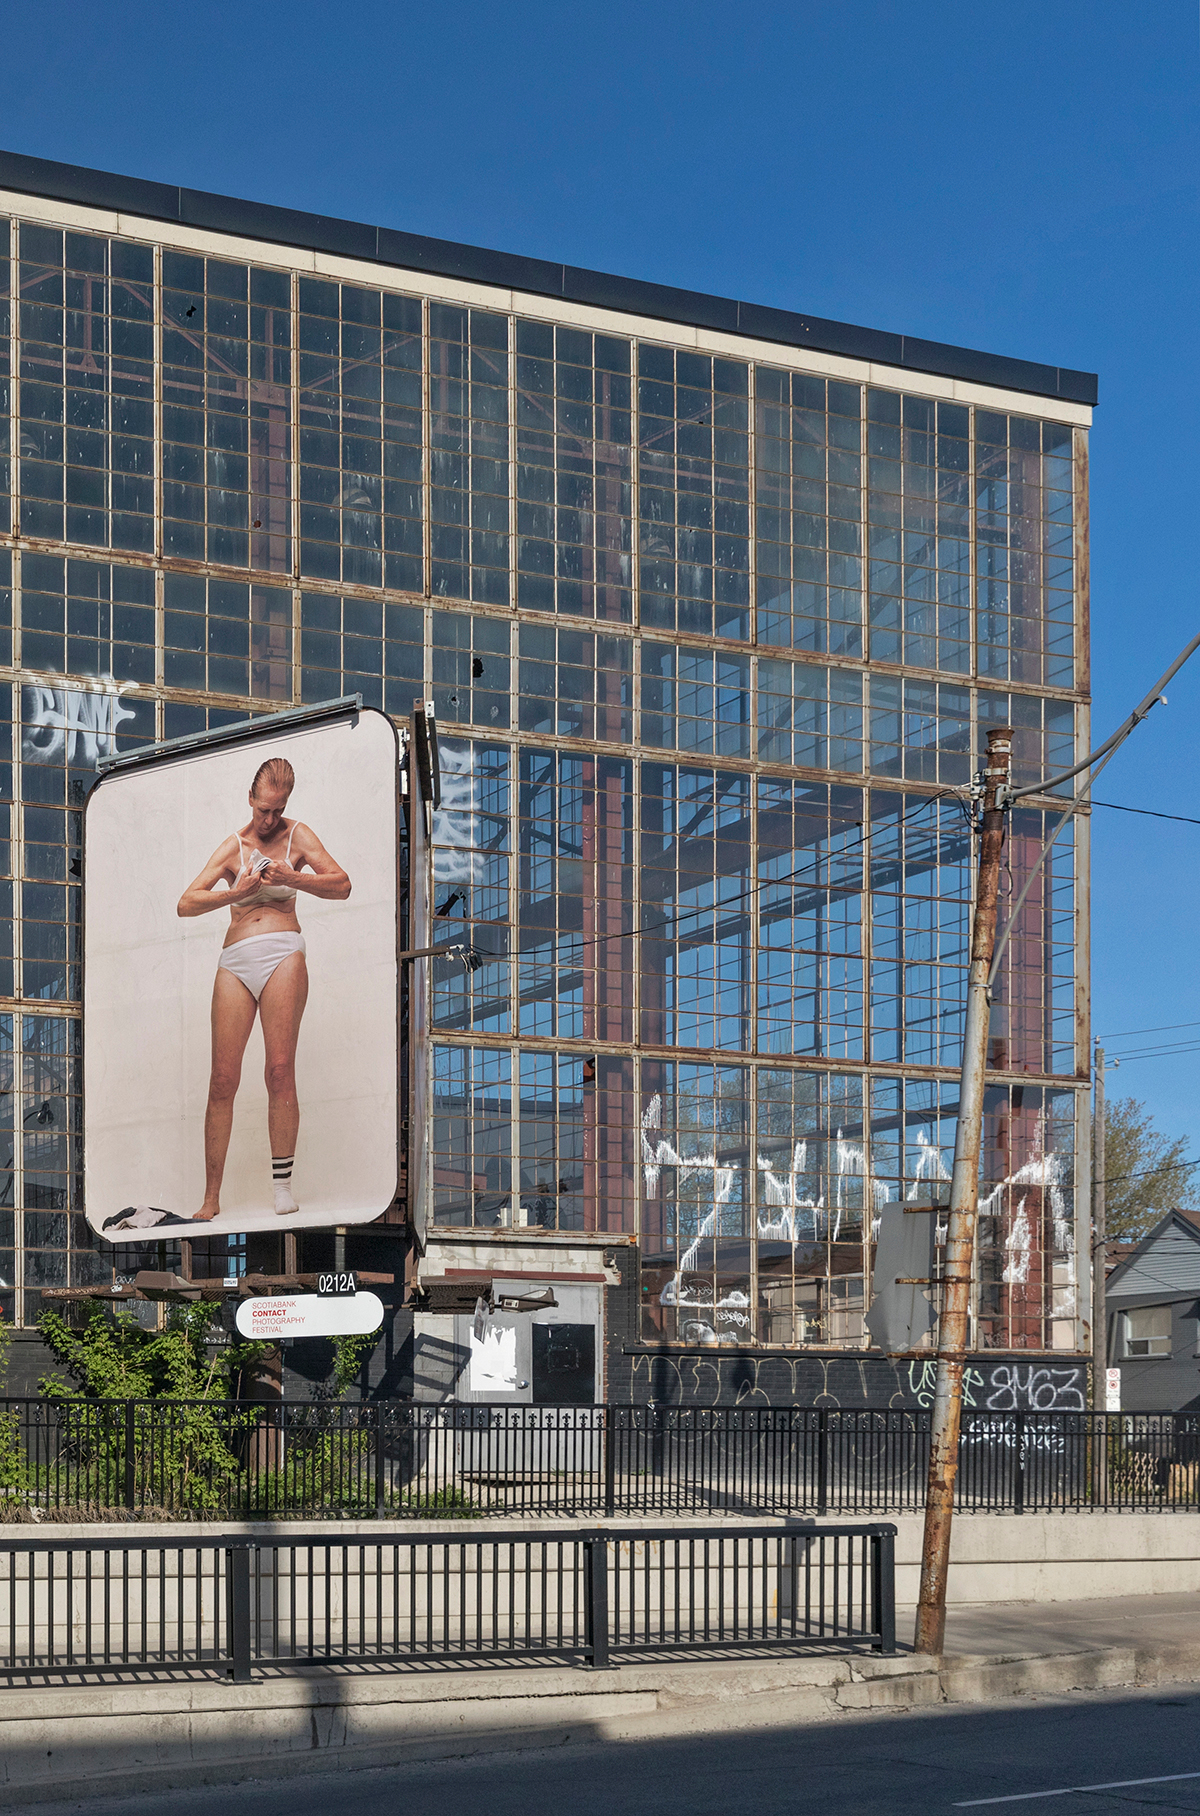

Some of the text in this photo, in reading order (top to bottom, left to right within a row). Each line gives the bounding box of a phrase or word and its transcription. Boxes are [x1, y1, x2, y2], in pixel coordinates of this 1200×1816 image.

[318, 1272, 356, 1293] 0212A
[252, 1301, 297, 1310] SCOTIABANK
[252, 1309, 287, 1318] CONTACT
[252, 1317, 306, 1326] PHOTOGRAPHY
[252, 1326, 283, 1334] FESTIVAL
